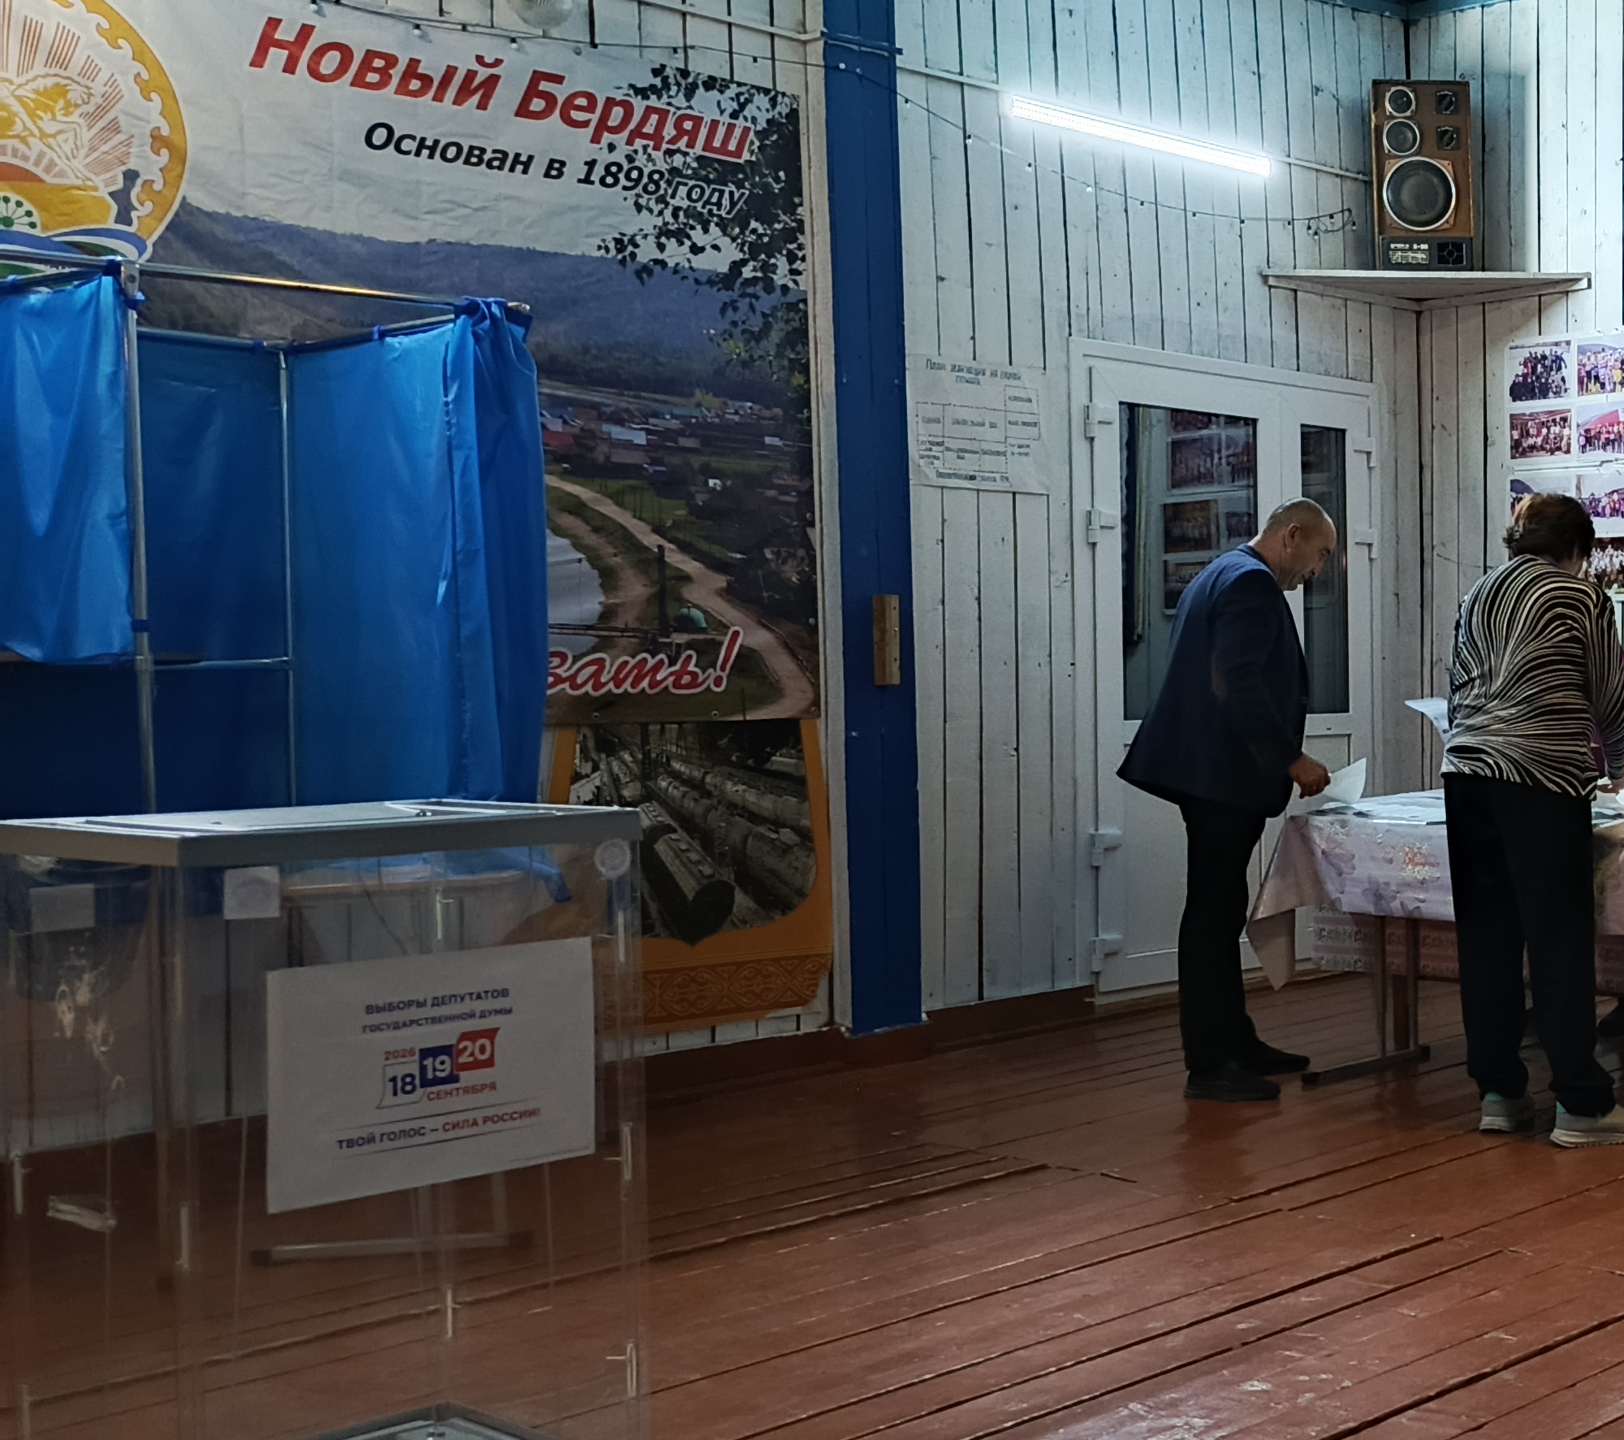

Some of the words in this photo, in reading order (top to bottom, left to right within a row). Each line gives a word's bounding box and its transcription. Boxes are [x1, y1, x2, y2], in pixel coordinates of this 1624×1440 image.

[249, 16, 504, 112] Новый
[514, 69, 752, 160] Бердяш
[364, 121, 535, 176] Основан
[543, 158, 567, 180] в
[577, 158, 666, 196] 1898
[669, 178, 749, 218] году
[365, 998, 427, 1015] ВЫБОРЫ
[431, 988, 510, 1008] ДЕПУТАТОВ
[362, 1008, 477, 1034] ГОСУДАРСТВЕННОЙ
[478, 1006, 513, 1020] ДУМЫ
[383, 1047, 416, 1061] 2026
[387, 1072, 417, 1097] 18
[422, 1055, 451, 1080] 19
[457, 1038, 492, 1063] 20
[426, 1082, 497, 1102] СЕНТЯБРЯ
[337, 1131, 376, 1150] ТВОЙ
[379, 1126, 427, 1143] ГОЛОС
[442, 1115, 479, 1133] СИЛА
[482, 1107, 541, 1126] РОССИИ!
